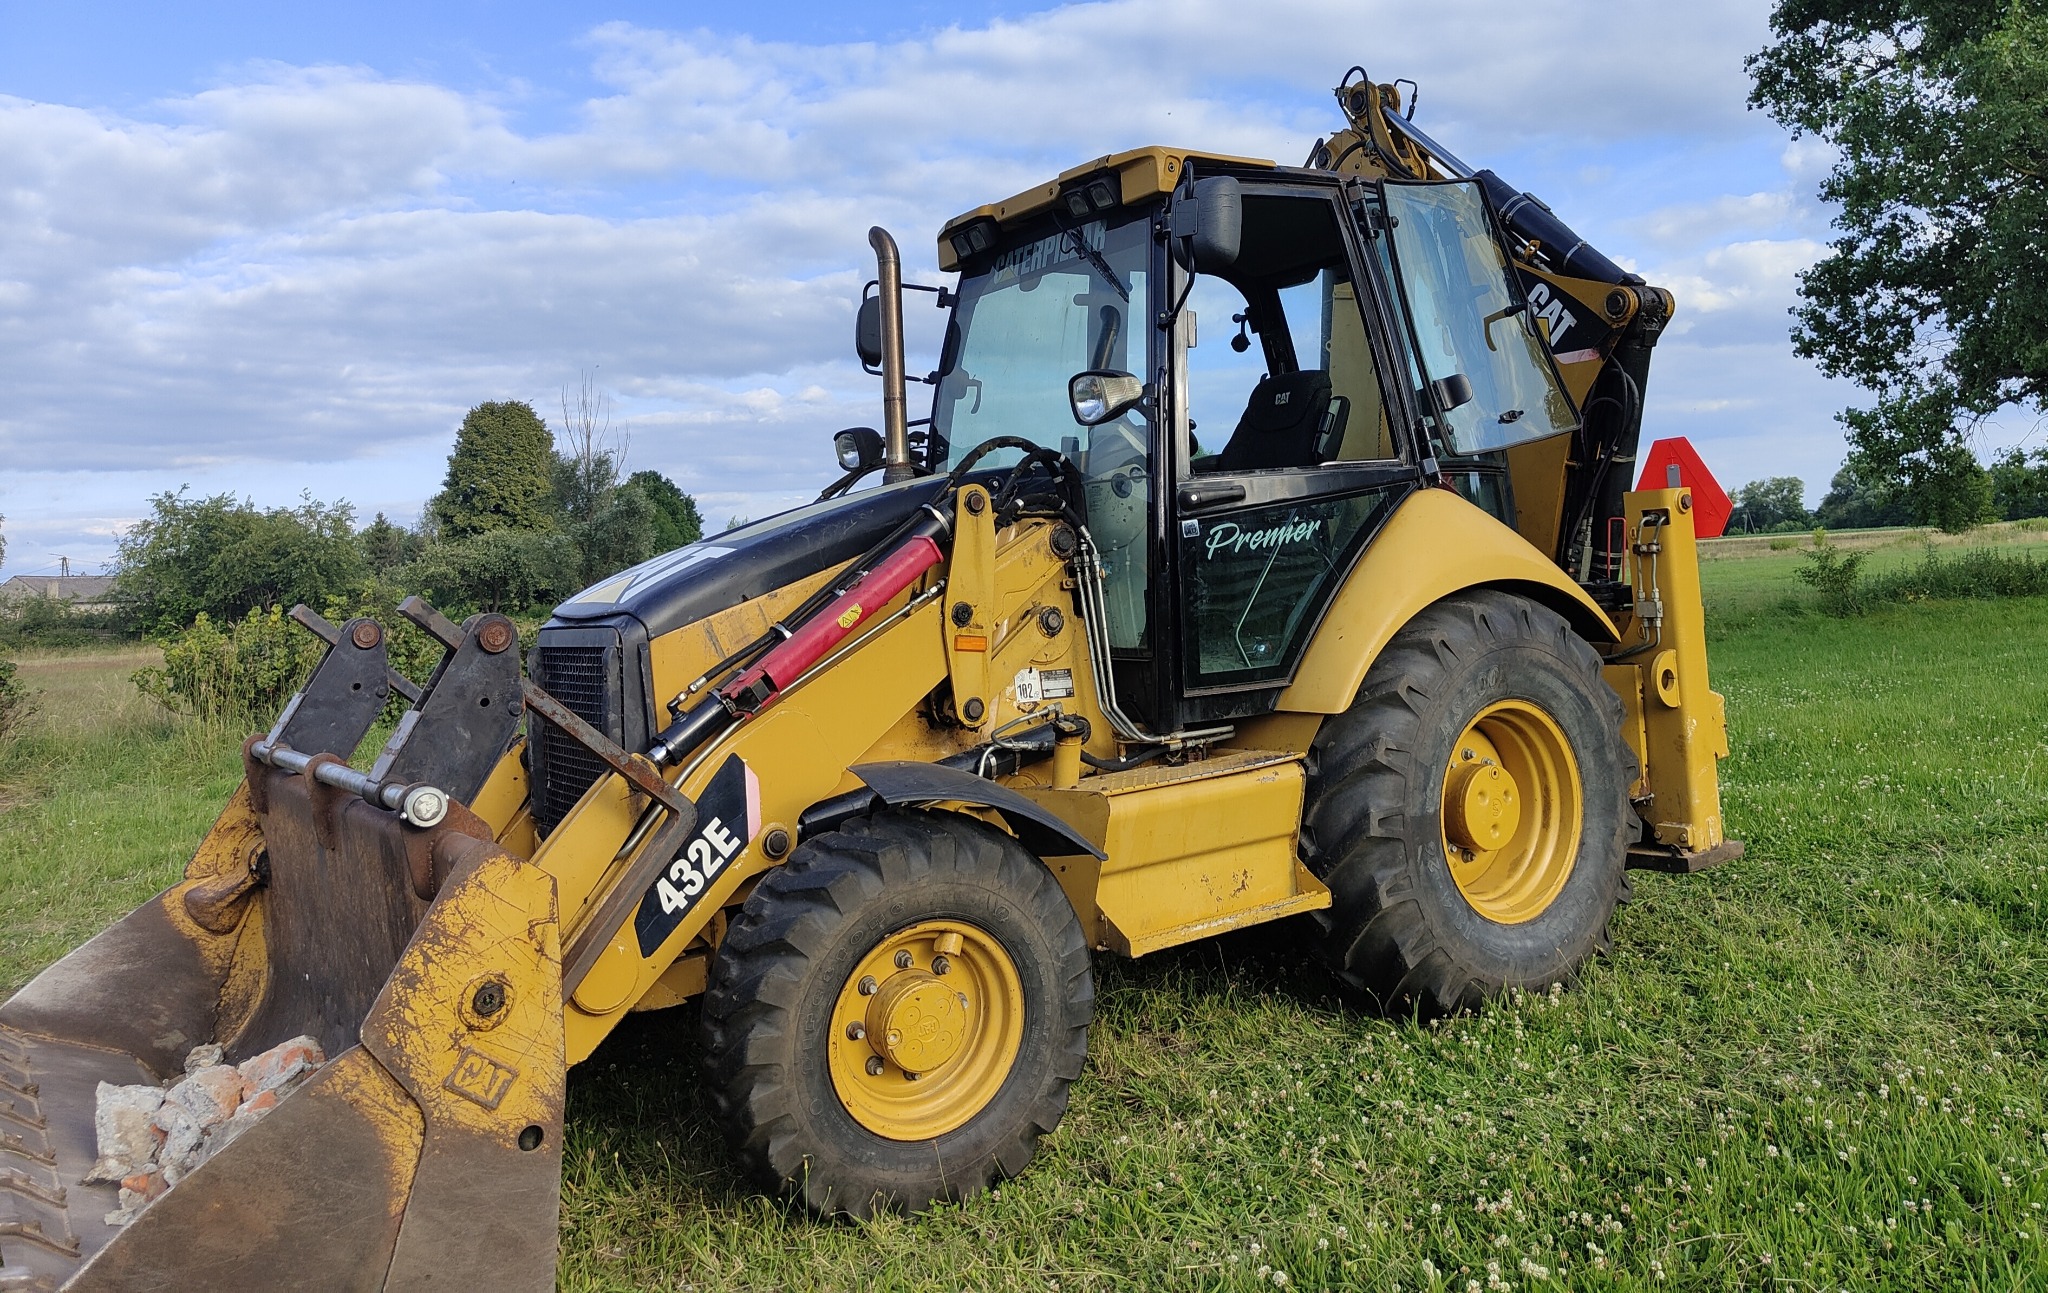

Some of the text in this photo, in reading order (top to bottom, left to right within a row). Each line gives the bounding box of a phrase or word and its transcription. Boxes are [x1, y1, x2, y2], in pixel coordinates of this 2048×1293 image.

[1527, 283, 1577, 347] CAT
[1275, 391, 1291, 405] CAT
[1205, 517, 1322, 560] Premier
[1017, 683, 1034, 699] 102
[656, 816, 742, 915] 432E
[453, 1054, 512, 1102] CAT
